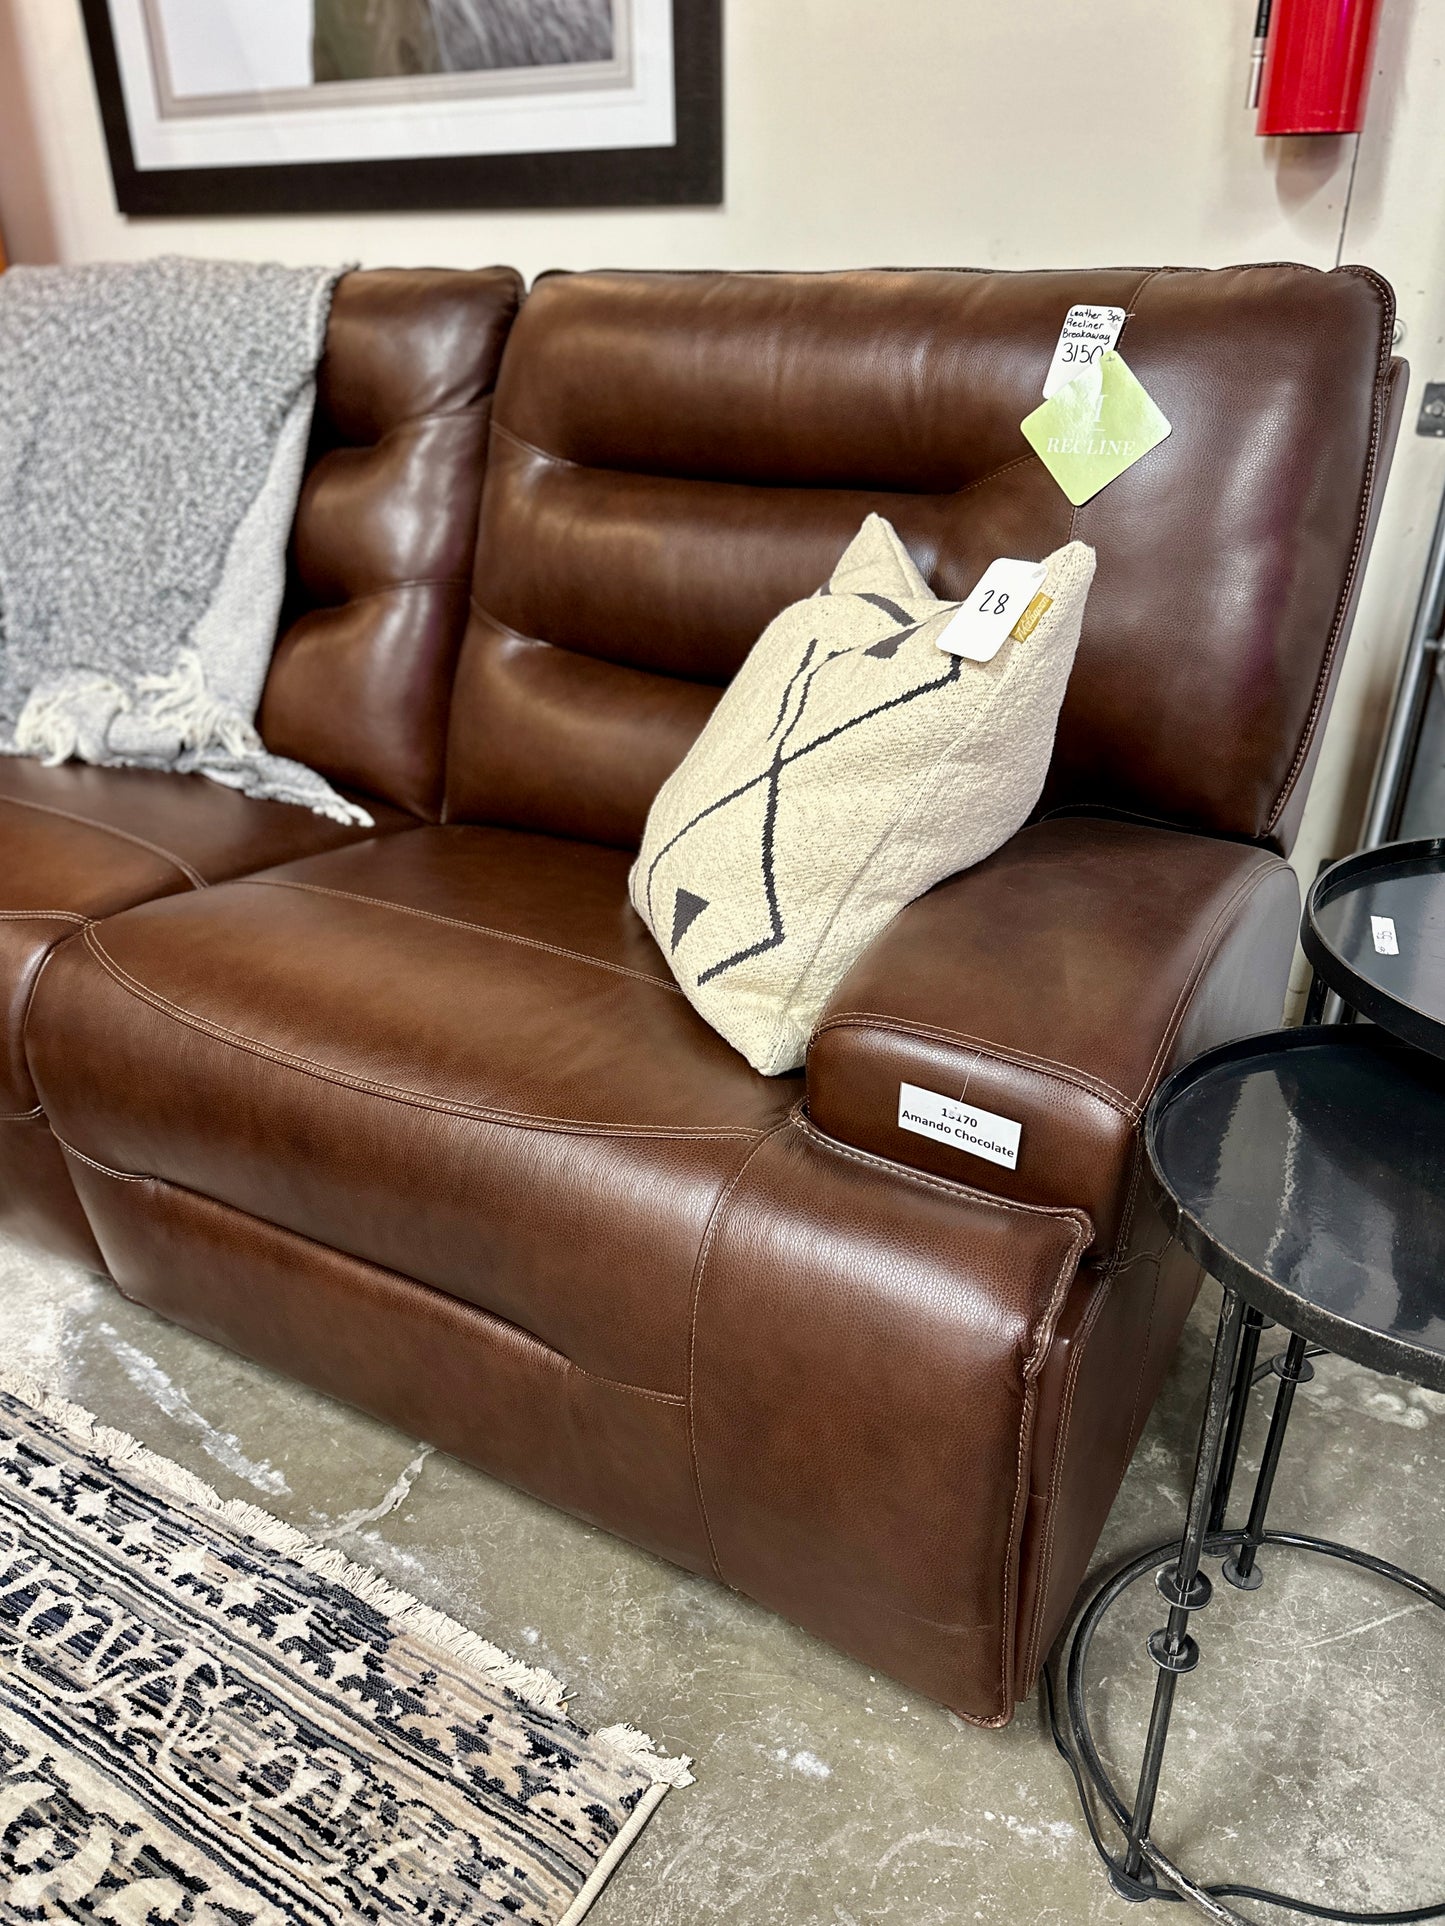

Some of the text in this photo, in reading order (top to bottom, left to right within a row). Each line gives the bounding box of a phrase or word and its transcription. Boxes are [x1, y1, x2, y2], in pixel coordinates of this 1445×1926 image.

[1070, 309, 1102, 319] Leather
[1066, 318, 1104, 330] Recliner
[1062, 328, 1110, 345] Breakaway
[1062, 342, 1104, 364] 3150
[1046, 438, 1135, 456] RECLINE
[979, 589, 1010, 615] 28
[901, 1110, 1015, 1158] Amando Chocolate
